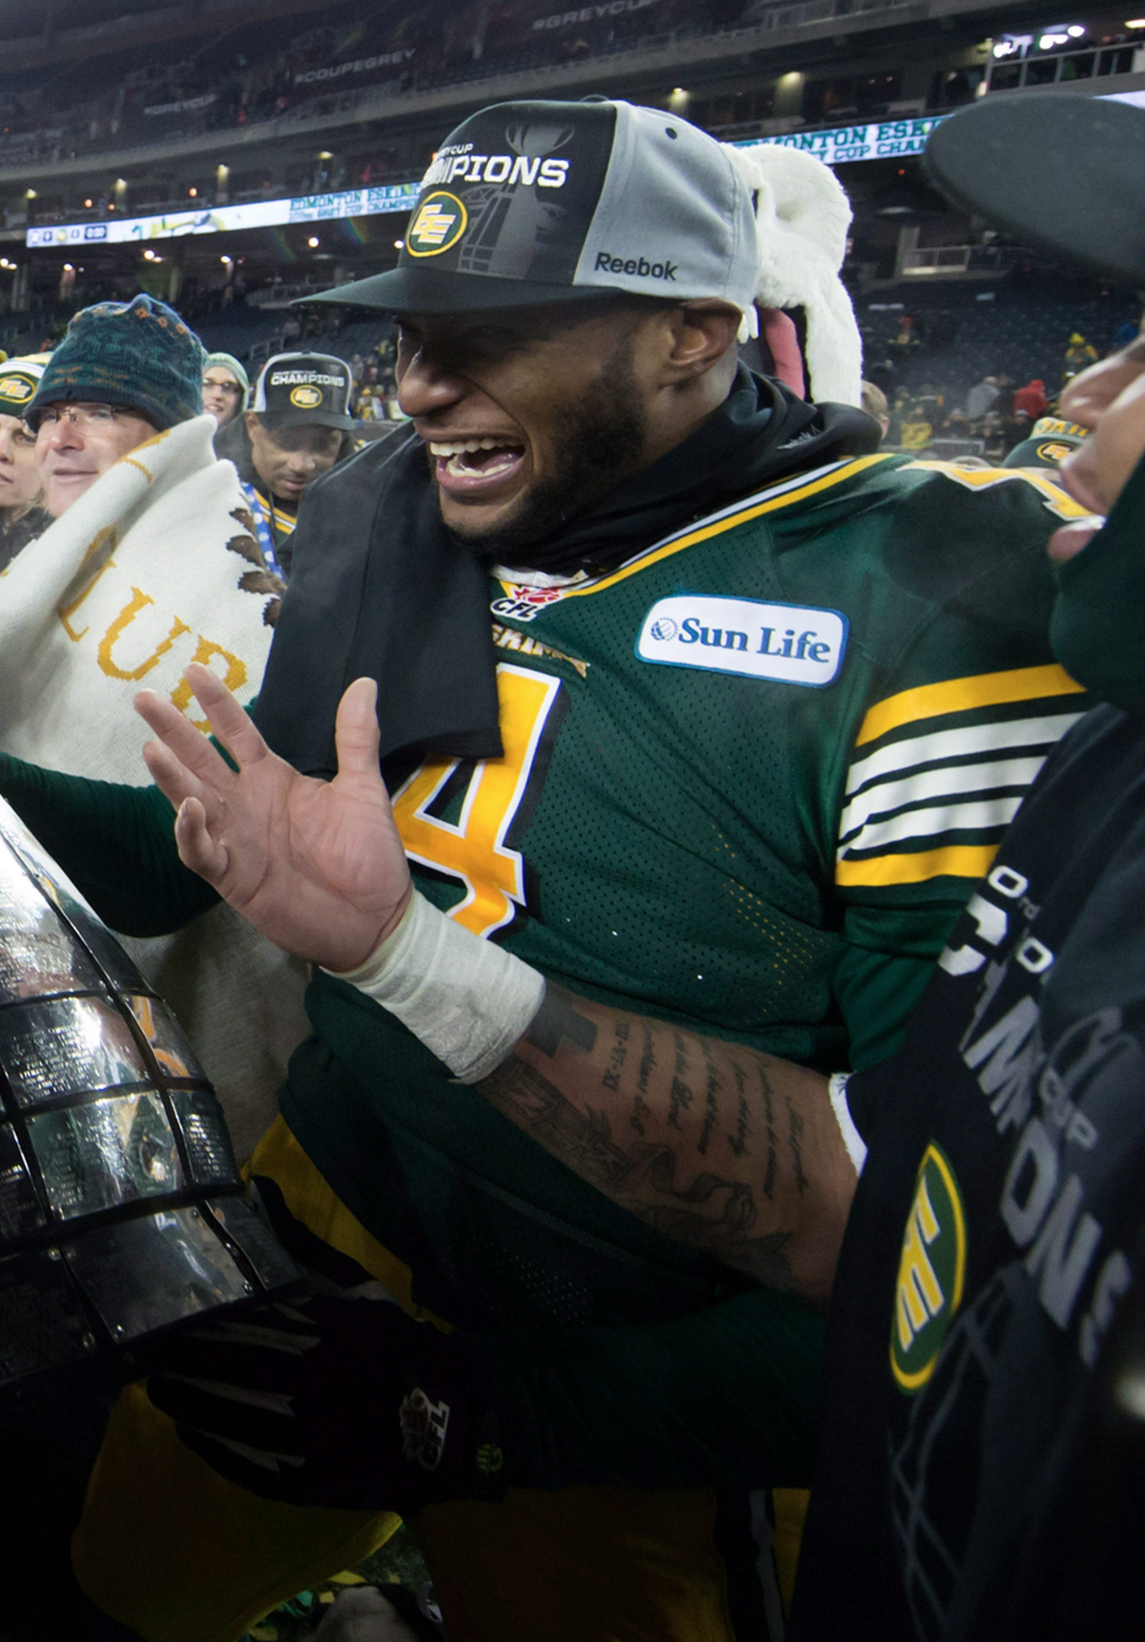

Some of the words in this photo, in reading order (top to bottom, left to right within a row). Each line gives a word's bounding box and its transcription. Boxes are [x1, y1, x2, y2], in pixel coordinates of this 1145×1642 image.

[295, 49, 416, 84] #COUPEGREY
[834, 145, 871, 161] CUP
[594, 251, 678, 281] Reebok
[270, 373, 345, 387] CHAMPIONS
[491, 598, 539, 619] CFL
[678, 617, 749, 652] Sun
[756, 626, 832, 663] Life
[390, 661, 564, 940] 4
